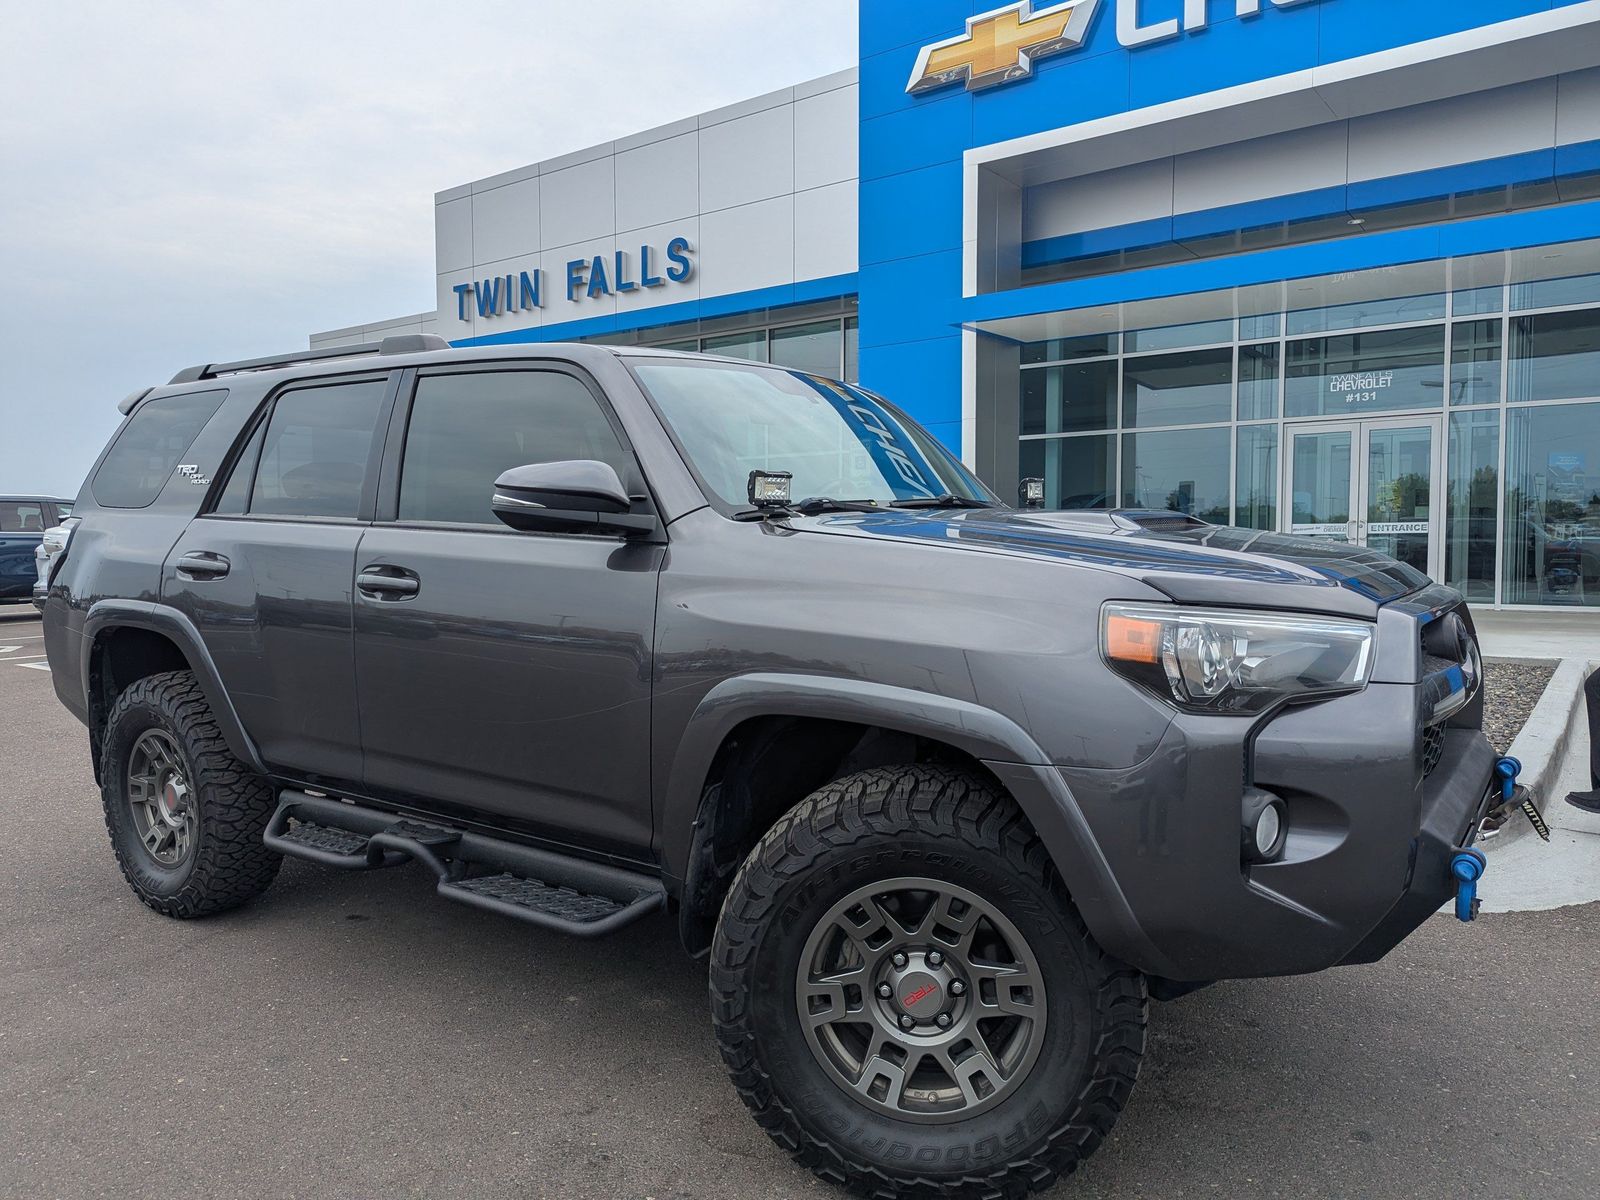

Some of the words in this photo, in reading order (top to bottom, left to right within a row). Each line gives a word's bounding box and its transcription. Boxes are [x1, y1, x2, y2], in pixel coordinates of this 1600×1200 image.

[453, 268, 544, 321] TWIN
[566, 236, 694, 302] FALLS
[1330, 377, 1392, 392] CHEVROLET
[1345, 391, 1377, 403] #131
[177, 464, 199, 477] TRD
[1370, 523, 1427, 532] ENTRANCE
[902, 984, 937, 1008] TRD
